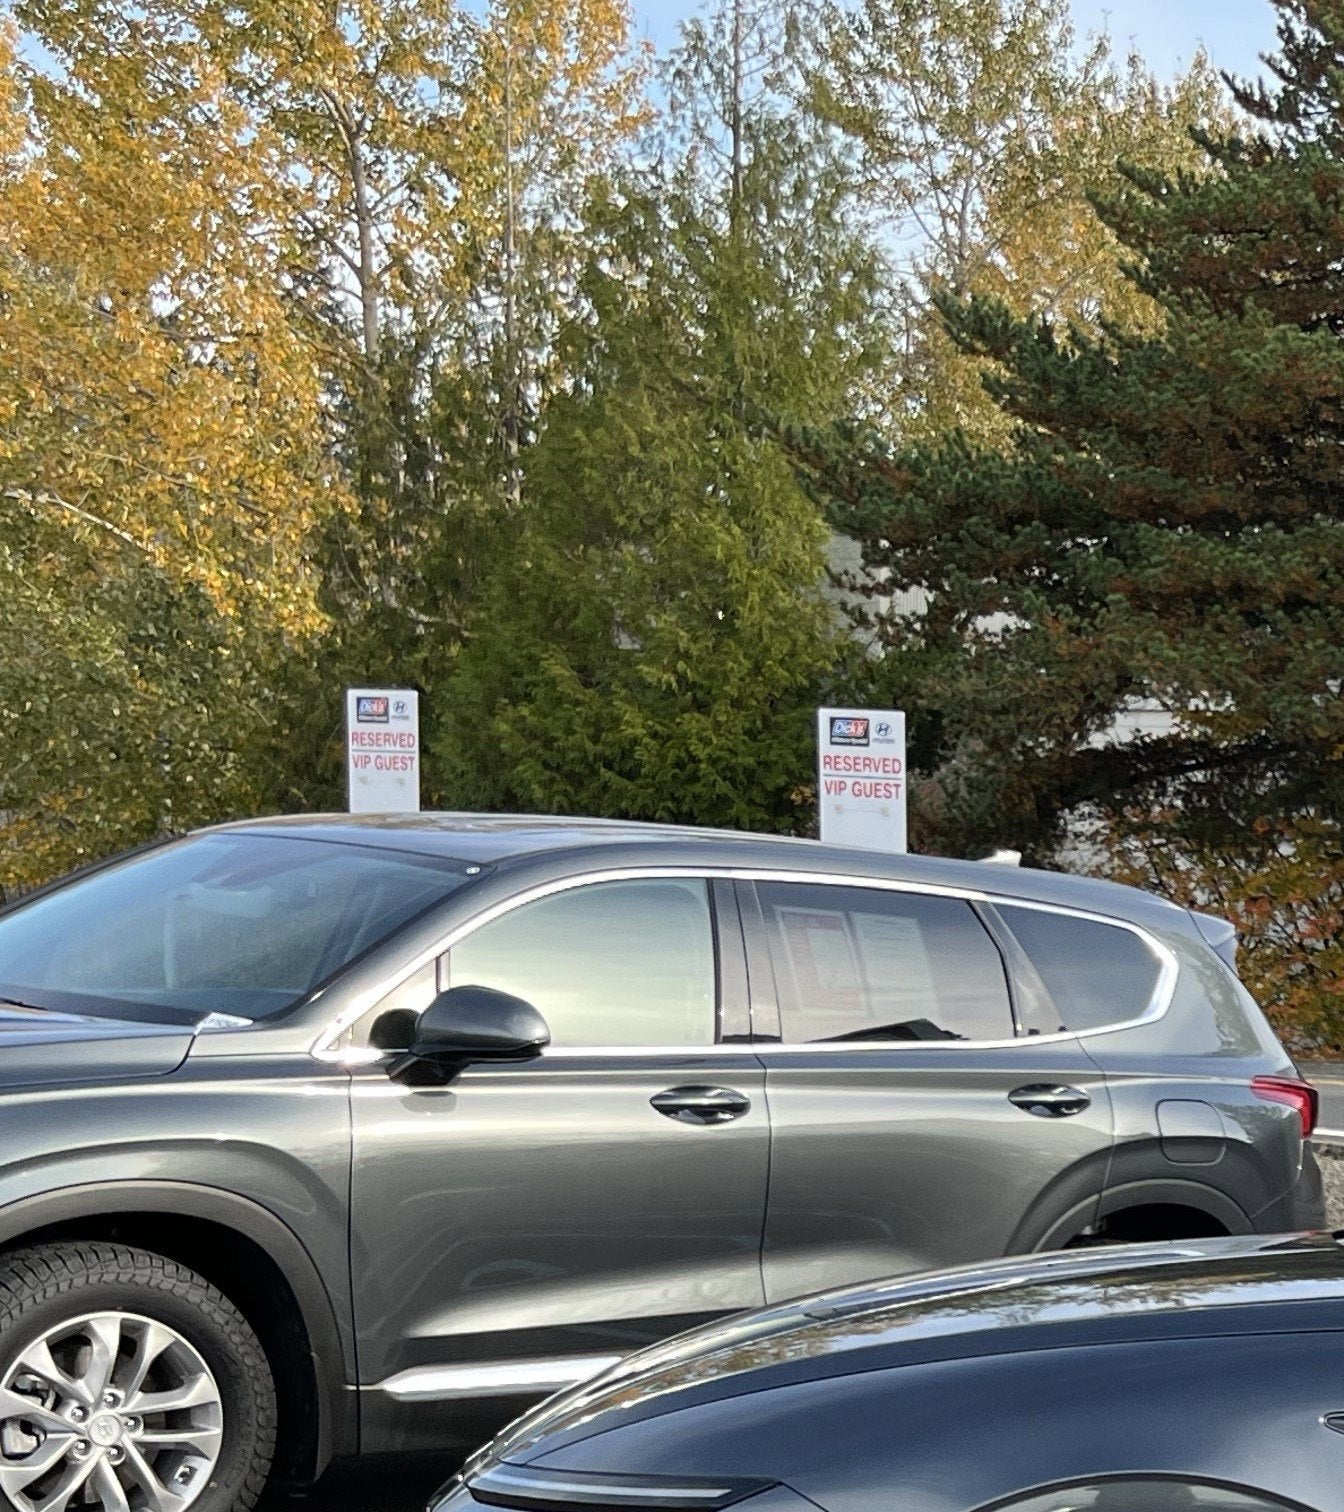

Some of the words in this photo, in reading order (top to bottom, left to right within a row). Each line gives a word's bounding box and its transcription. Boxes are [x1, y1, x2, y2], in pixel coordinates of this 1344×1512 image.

[351, 731, 416, 749] RESERVED
[352, 755, 371, 770] VIP
[374, 756, 415, 771] GUEST
[823, 755, 902, 774] RESERVED
[824, 780, 847, 796] VIP
[851, 780, 902, 799] GUEST
